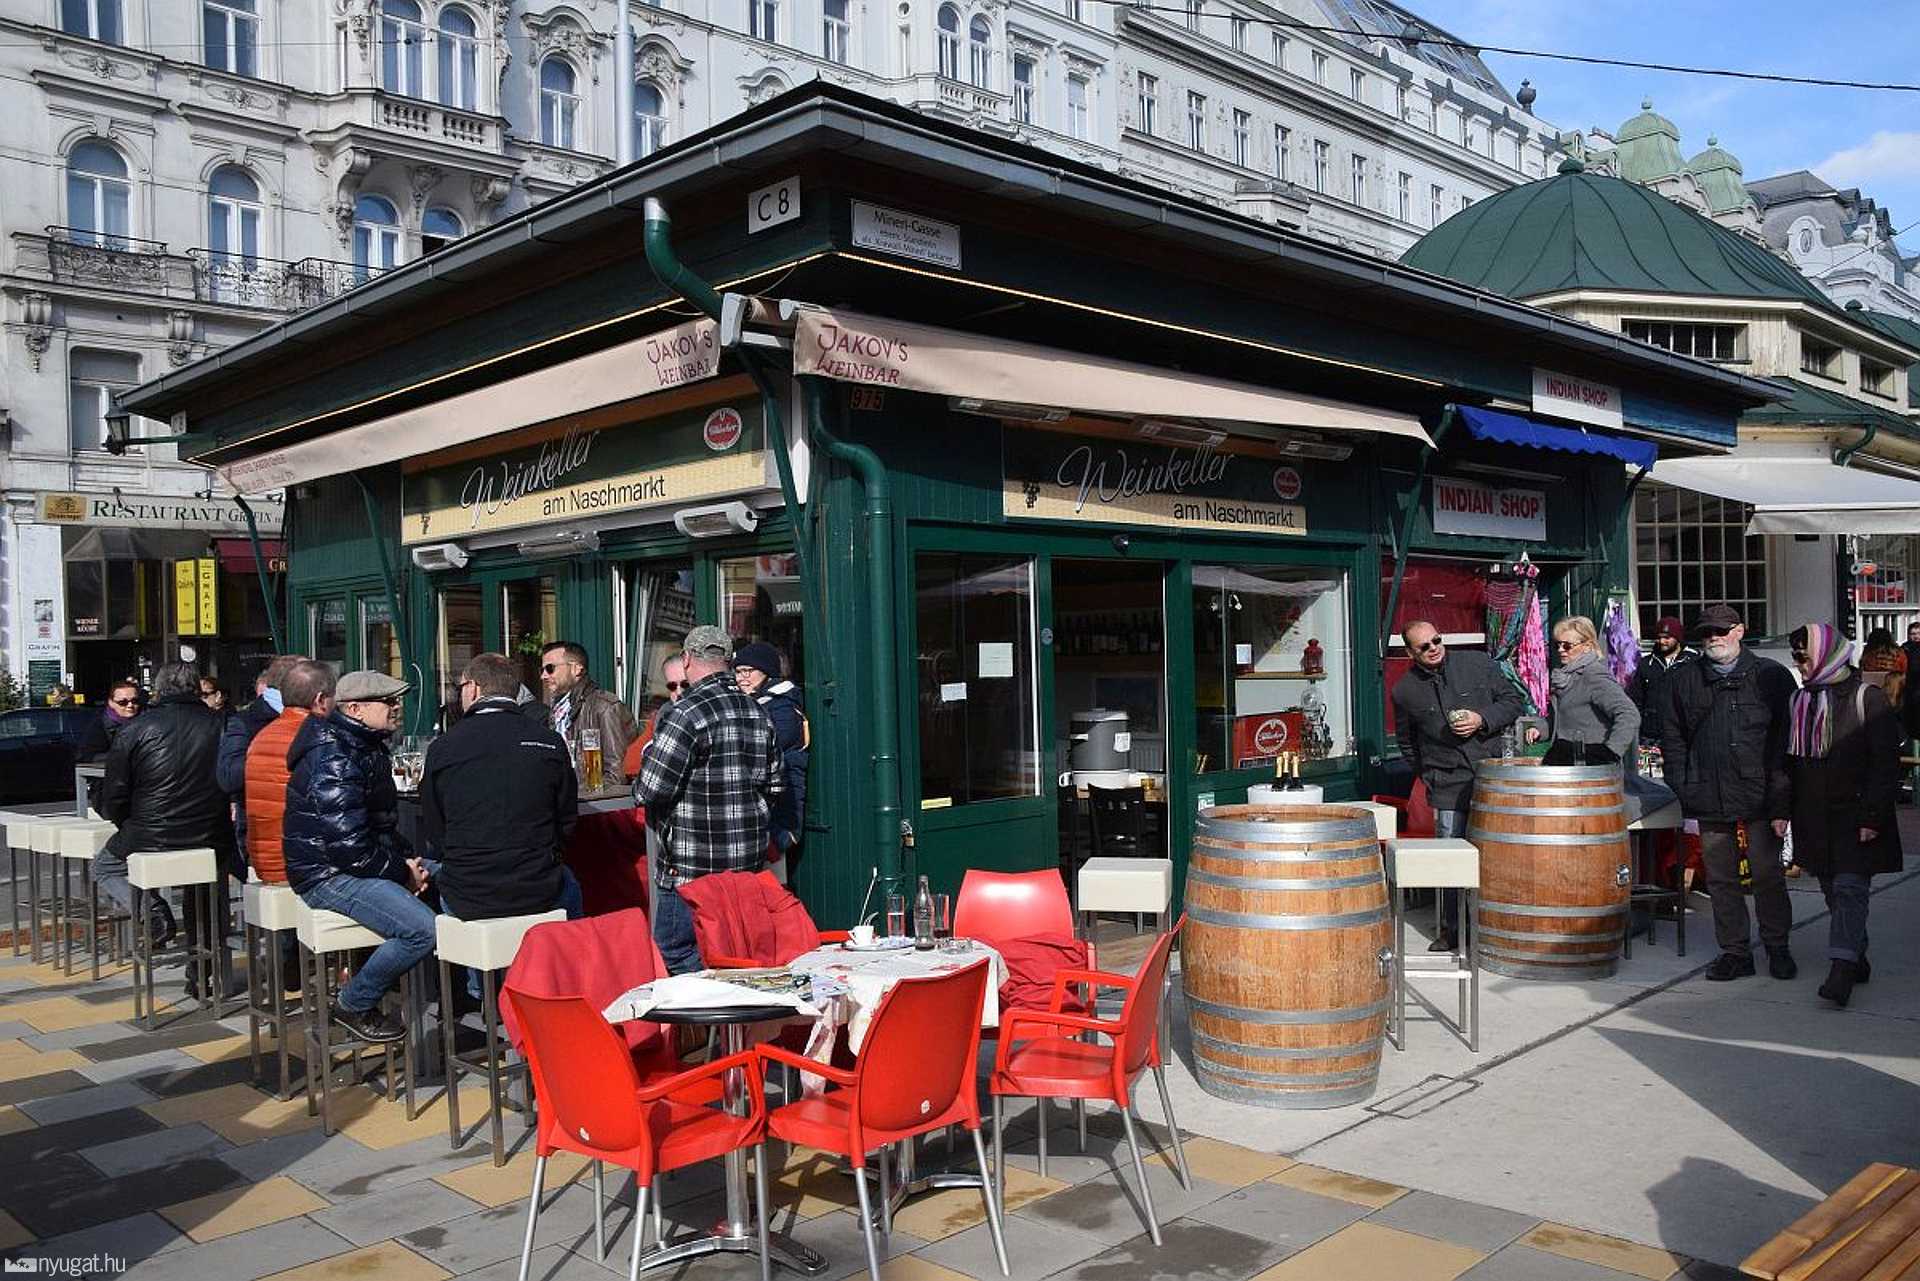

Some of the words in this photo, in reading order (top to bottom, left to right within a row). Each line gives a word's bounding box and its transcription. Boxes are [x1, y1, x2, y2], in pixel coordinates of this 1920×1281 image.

[757, 193, 772, 222] C
[778, 187, 790, 215] 8
[646, 330, 713, 364] JAKOV'S
[816, 323, 909, 362] JAKOV'S
[815, 353, 901, 385] WEINBAR
[1545, 376, 1581, 401] INDIAN
[1582, 386, 1609, 408] SHOP
[460, 426, 600, 529] Weinkeller
[1056, 445, 1235, 513] Weinkeller
[543, 495, 566, 516] am
[570, 475, 666, 512] Naschmarkt
[1439, 486, 1494, 514] INDIAN
[1500, 493, 1538, 519] SHOP
[228, 508, 272, 523] GRFIN
[1173, 503, 1200, 520] am
[1205, 501, 1295, 528] Naschmarkt
